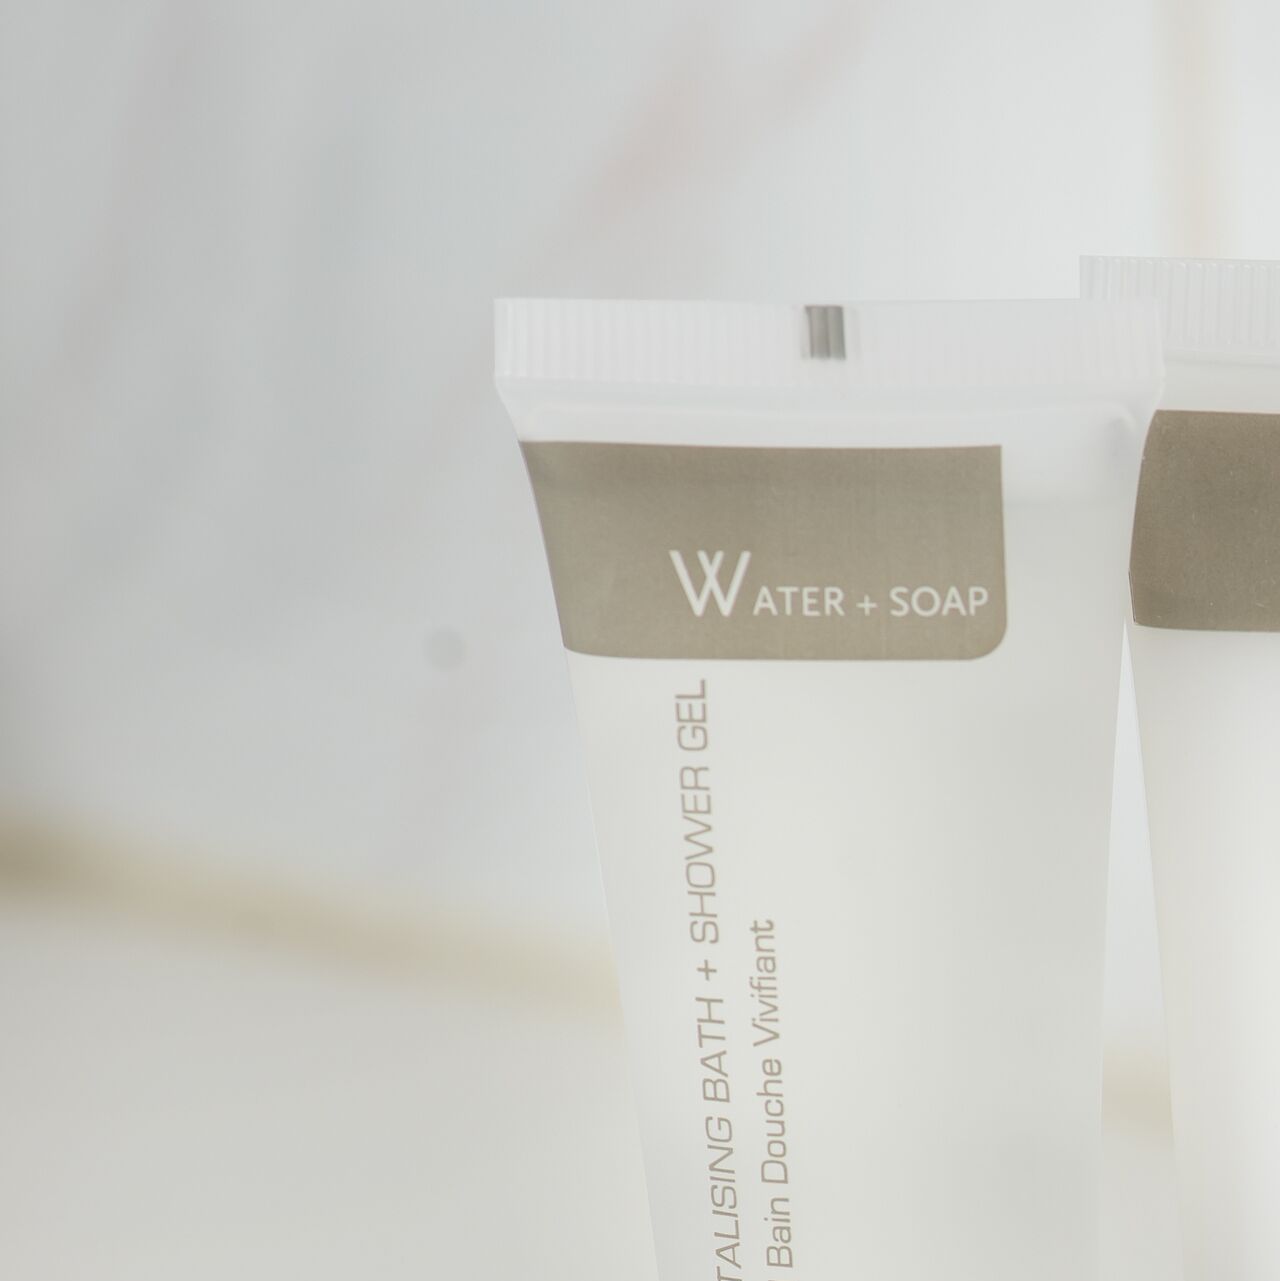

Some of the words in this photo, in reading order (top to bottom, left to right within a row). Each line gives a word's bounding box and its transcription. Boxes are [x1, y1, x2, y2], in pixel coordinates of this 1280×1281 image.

[856, 594, 878, 616] +
[890, 586, 989, 617] SOAP
[674, 679, 708, 752] GEL
[679, 765, 720, 944] SHOWER
[697, 959, 718, 981] +
[749, 919, 781, 1048] Vivifiant
[695, 996, 731, 1104] BATH
[756, 1058, 790, 1185] Douche
[763, 1197, 794, 1268] Bain
